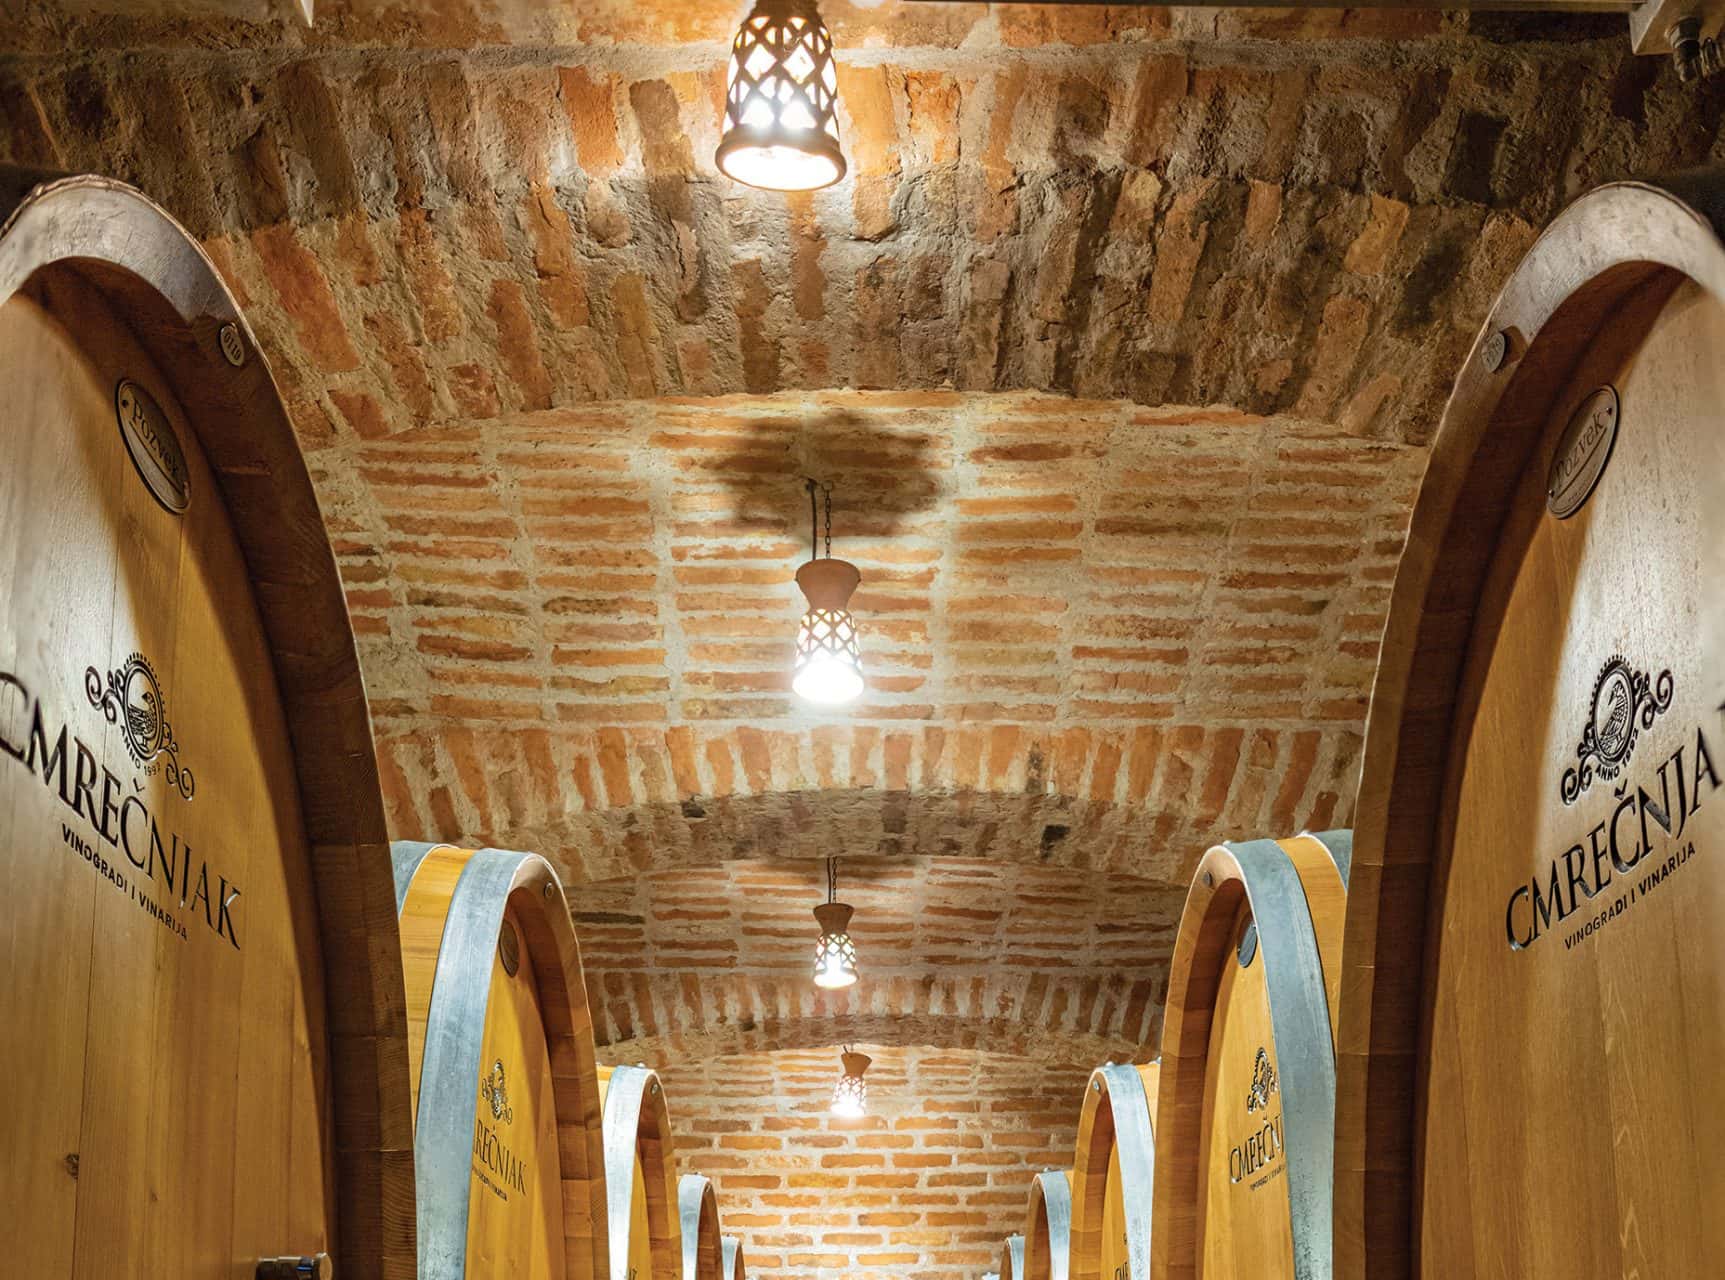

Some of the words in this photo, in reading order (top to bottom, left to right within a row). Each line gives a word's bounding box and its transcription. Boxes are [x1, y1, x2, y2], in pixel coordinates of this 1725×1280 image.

[1506, 701, 1725, 951] CMREČNJA
[1595, 764, 1620, 781] ANNO
[61, 823, 128, 891] VINOGRADI
[138, 893, 188, 942] VINARIJA
[1564, 898, 1628, 950] VINOGRADI
[1638, 840, 1696, 897] VINARIJA
